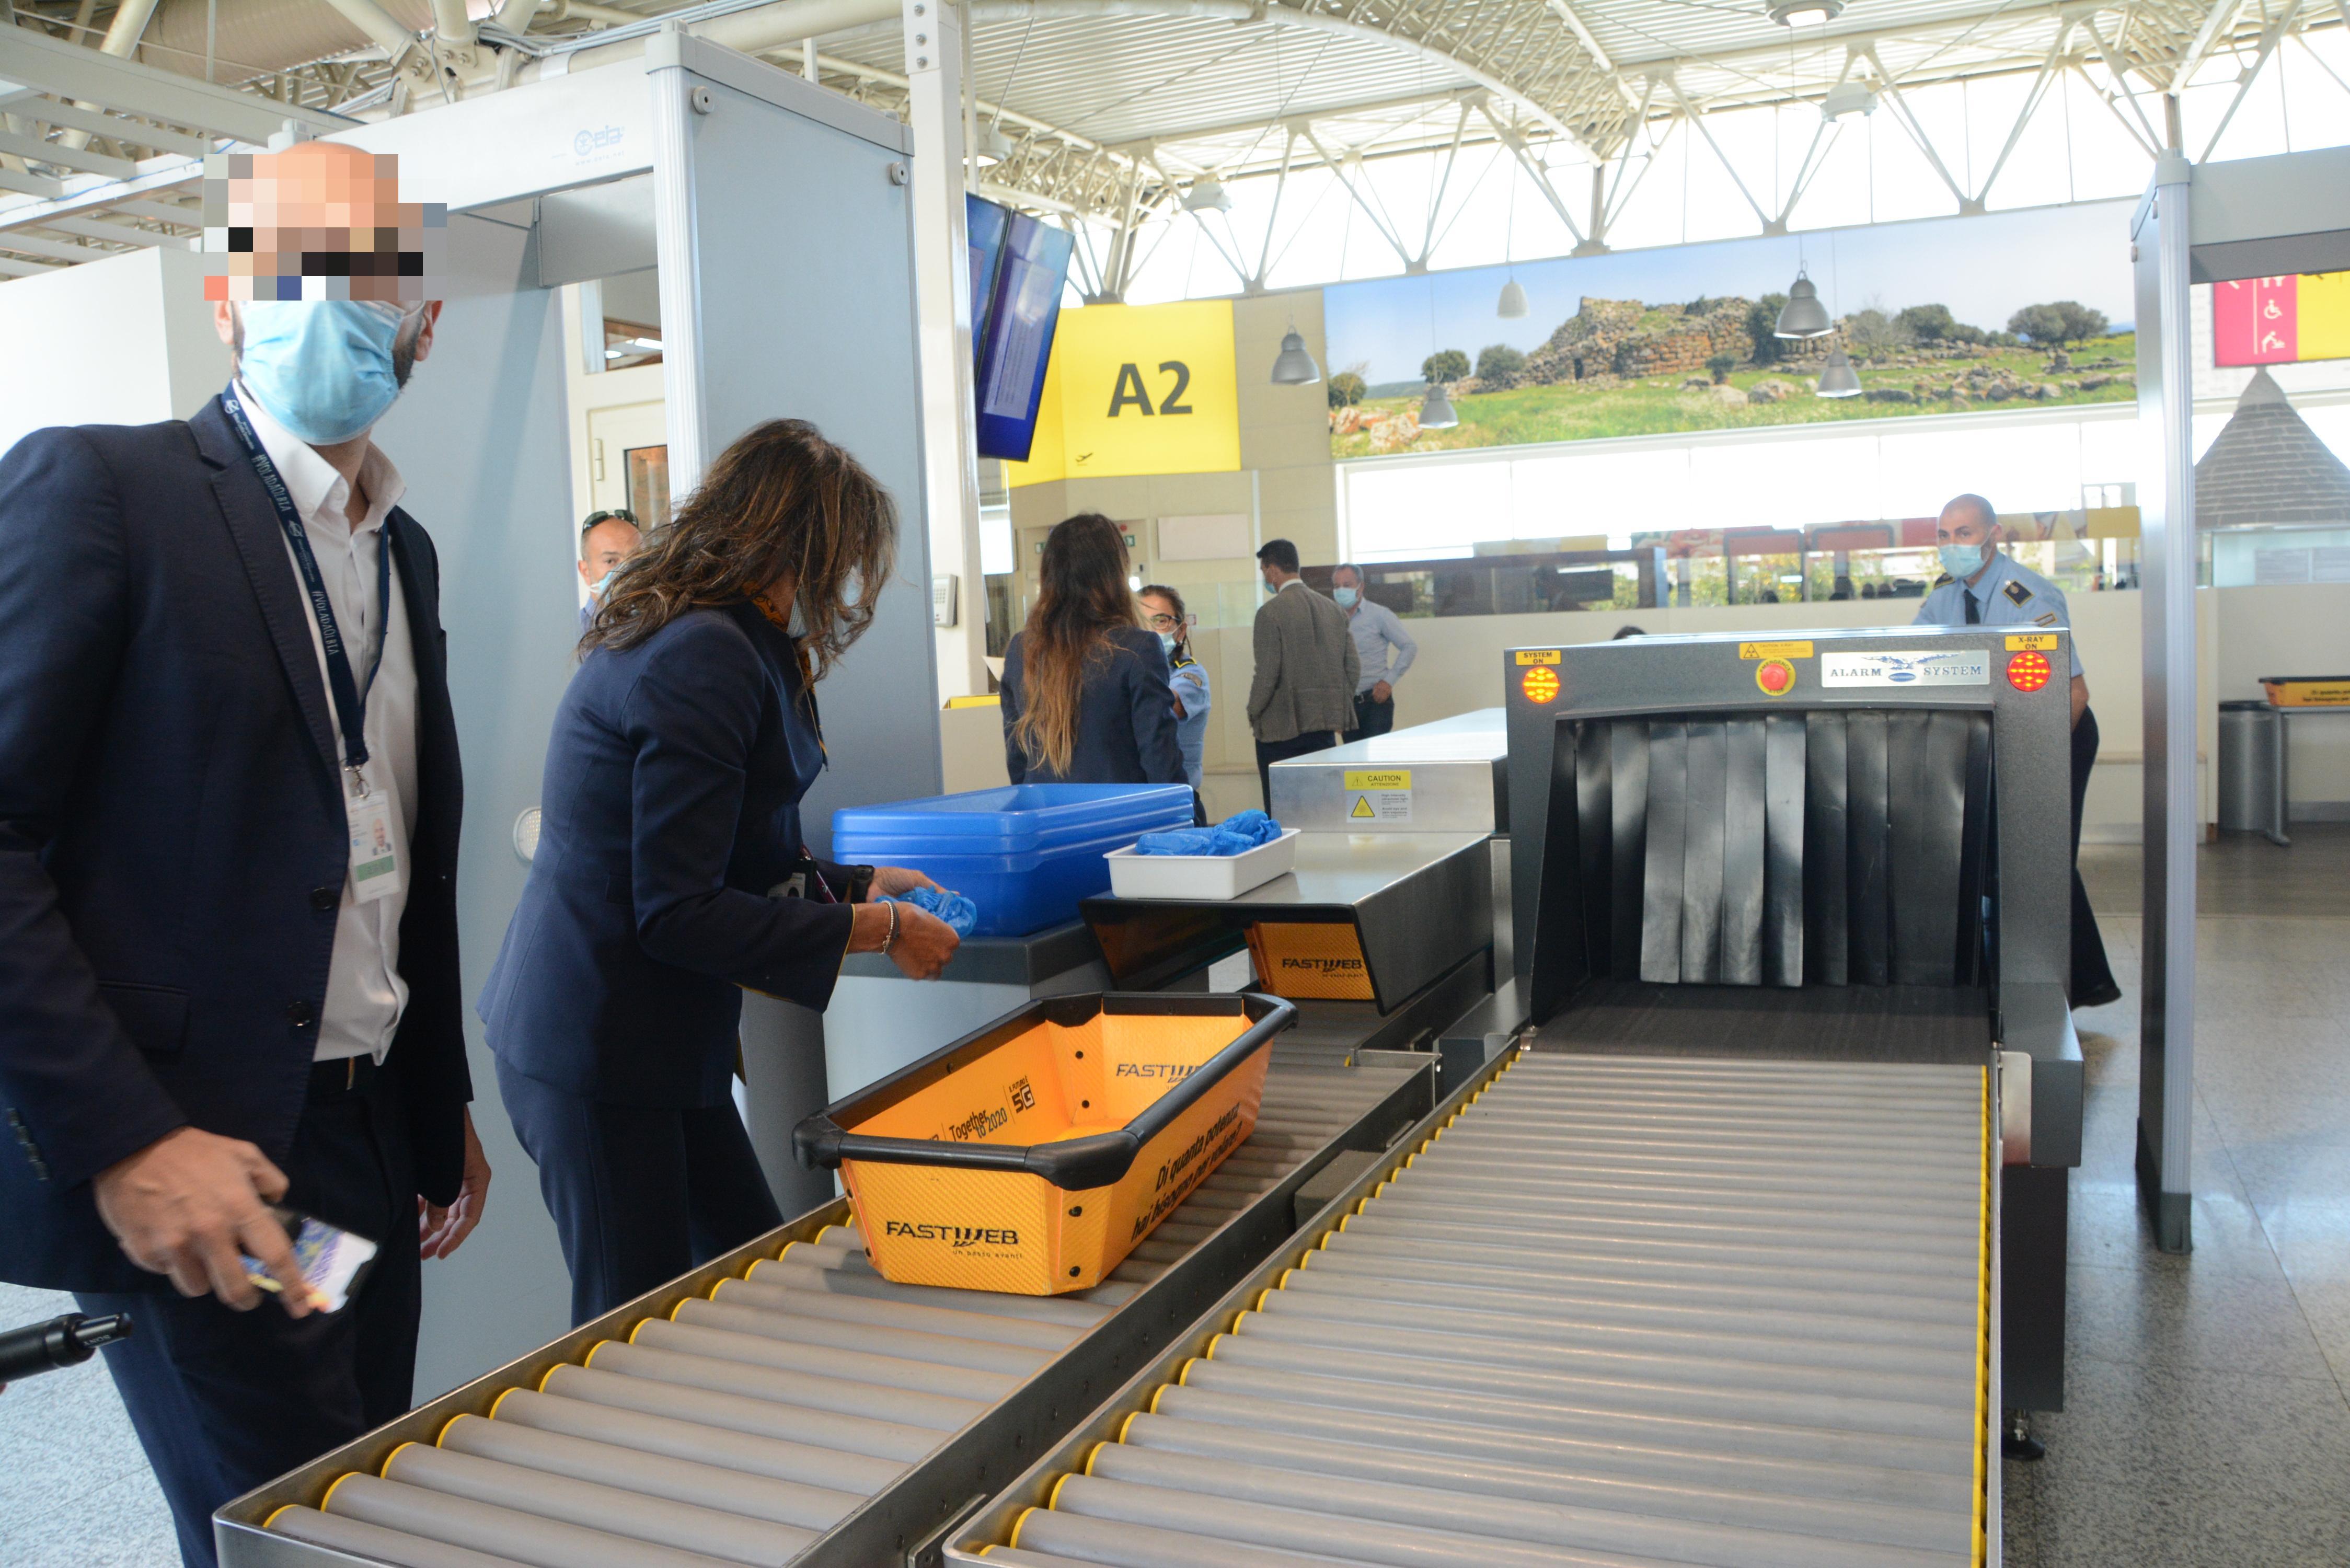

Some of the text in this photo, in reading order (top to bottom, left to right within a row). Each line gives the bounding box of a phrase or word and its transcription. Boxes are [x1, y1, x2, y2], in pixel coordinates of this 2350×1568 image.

[1107, 361, 1192, 417] A2
[1759, 660, 1791, 673] EMERGENCY
[1830, 665, 1982, 677] ALARM SYSTEM
[1282, 958, 1362, 973] FASTWEB
[1116, 1063, 1203, 1083] FASTW
[1011, 1083, 1035, 1114] 5G
[949, 1109, 987, 1142] Together
[975, 1107, 1008, 1139] to 2020
[1155, 1102, 1240, 1193] Di quanta potenza
[1131, 1204, 1154, 1243] hai
[1151, 1172, 1193, 1224] bisogno
[1190, 1156, 1211, 1189] per
[886, 1221, 1019, 1247] FASTWEB
